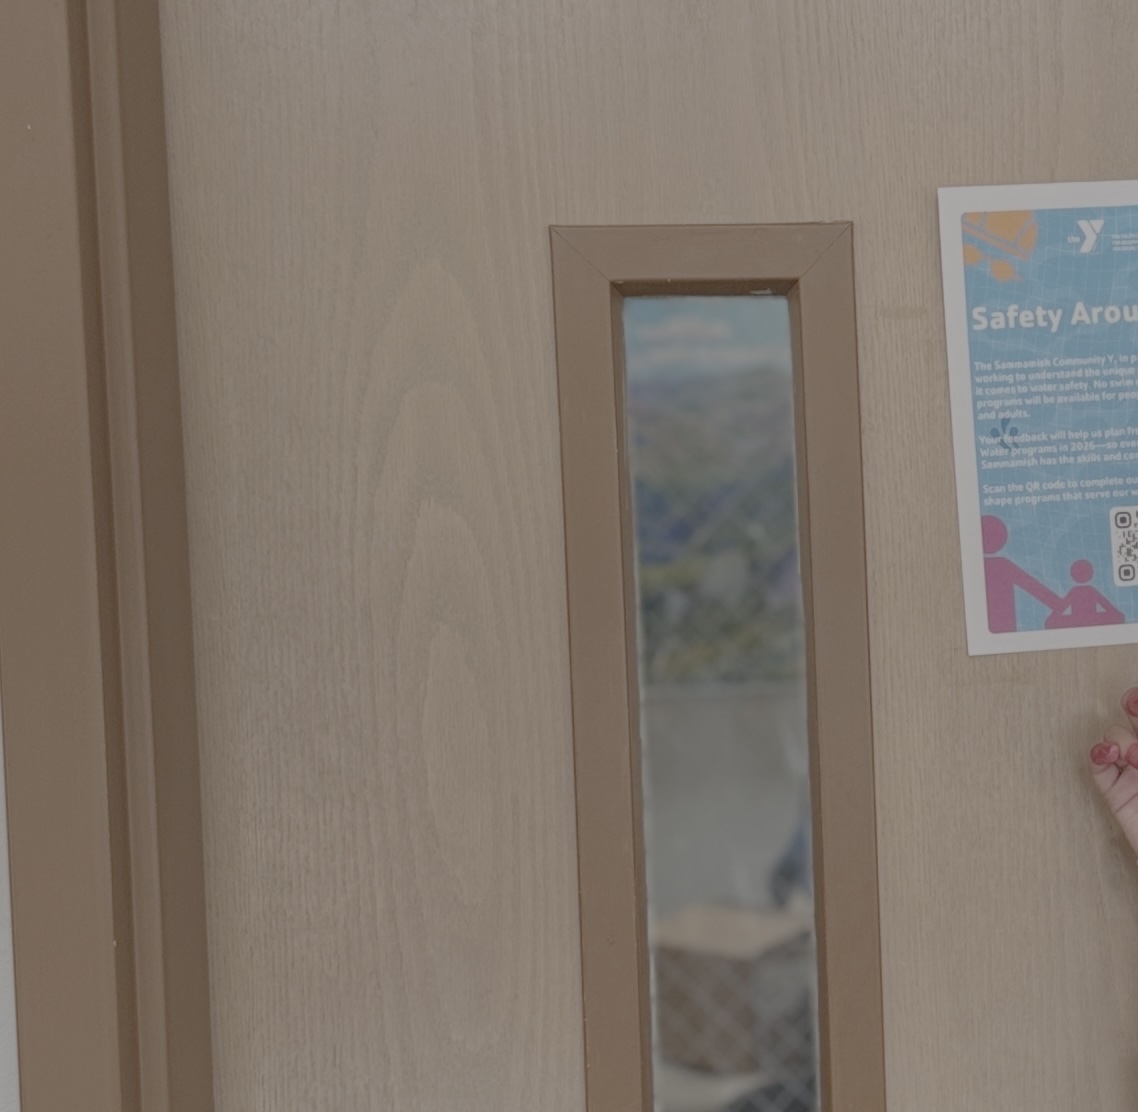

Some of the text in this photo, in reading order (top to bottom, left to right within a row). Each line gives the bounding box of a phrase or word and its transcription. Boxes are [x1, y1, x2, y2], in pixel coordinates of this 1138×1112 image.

[1067, 219, 1105, 254] the Y
[972, 303, 1063, 333] Safety
[974, 361, 992, 371] The
[994, 357, 1051, 370] Sammamish
[1052, 354, 1106, 367] Community
[1107, 354, 1117, 365] Y,
[1119, 354, 1128, 362] in
[975, 374, 1014, 384] working
[1028, 368, 1083, 380] understand
[1085, 367, 1100, 377] the
[1102, 365, 1136, 376] unique
[985, 387, 1016, 395] comes
[1017, 385, 1028, 393] to
[1030, 384, 1057, 393] water
[1093, 380, 1107, 388] No
[1109, 378, 1133, 386] swim
[976, 399, 1023, 410] programs
[1025, 396, 1041, 405] will
[1043, 395, 1055, 404] be
[1057, 391, 1101, 403] available
[1101, 391, 1115, 400] for
[977, 409, 1030, 420] and adults.
[979, 435, 1001, 445] Your
[1003, 433, 1048, 443] feedback
[1049, 431, 1066, 440] will
[1067, 430, 1089, 440] help
[1090, 430, 1102, 438] us
[1104, 427, 1126, 438] plan
[979, 447, 1009, 457] Water
[1011, 446, 1057, 457] programs
[1059, 443, 1068, 451] in
[981, 458, 1038, 469] Sammamish
[1039, 456, 1057, 465] has
[1059, 455, 1075, 464] the
[1076, 453, 1102, 463] skills
[1103, 452, 1122, 461] and
[982, 484, 1006, 494] Scan
[1007, 482, 1024, 491] the
[1025, 481, 1040, 492] QR
[1042, 480, 1065, 490] code
[1067, 479, 1078, 488] to
[1079, 476, 1123, 488] complete
[983, 495, 1013, 507] shape
[1014, 493, 1061, 505] programs
[1062, 492, 1083, 501] that
[1084, 491, 1110, 499] serve
[1112, 489, 1129, 498] our
